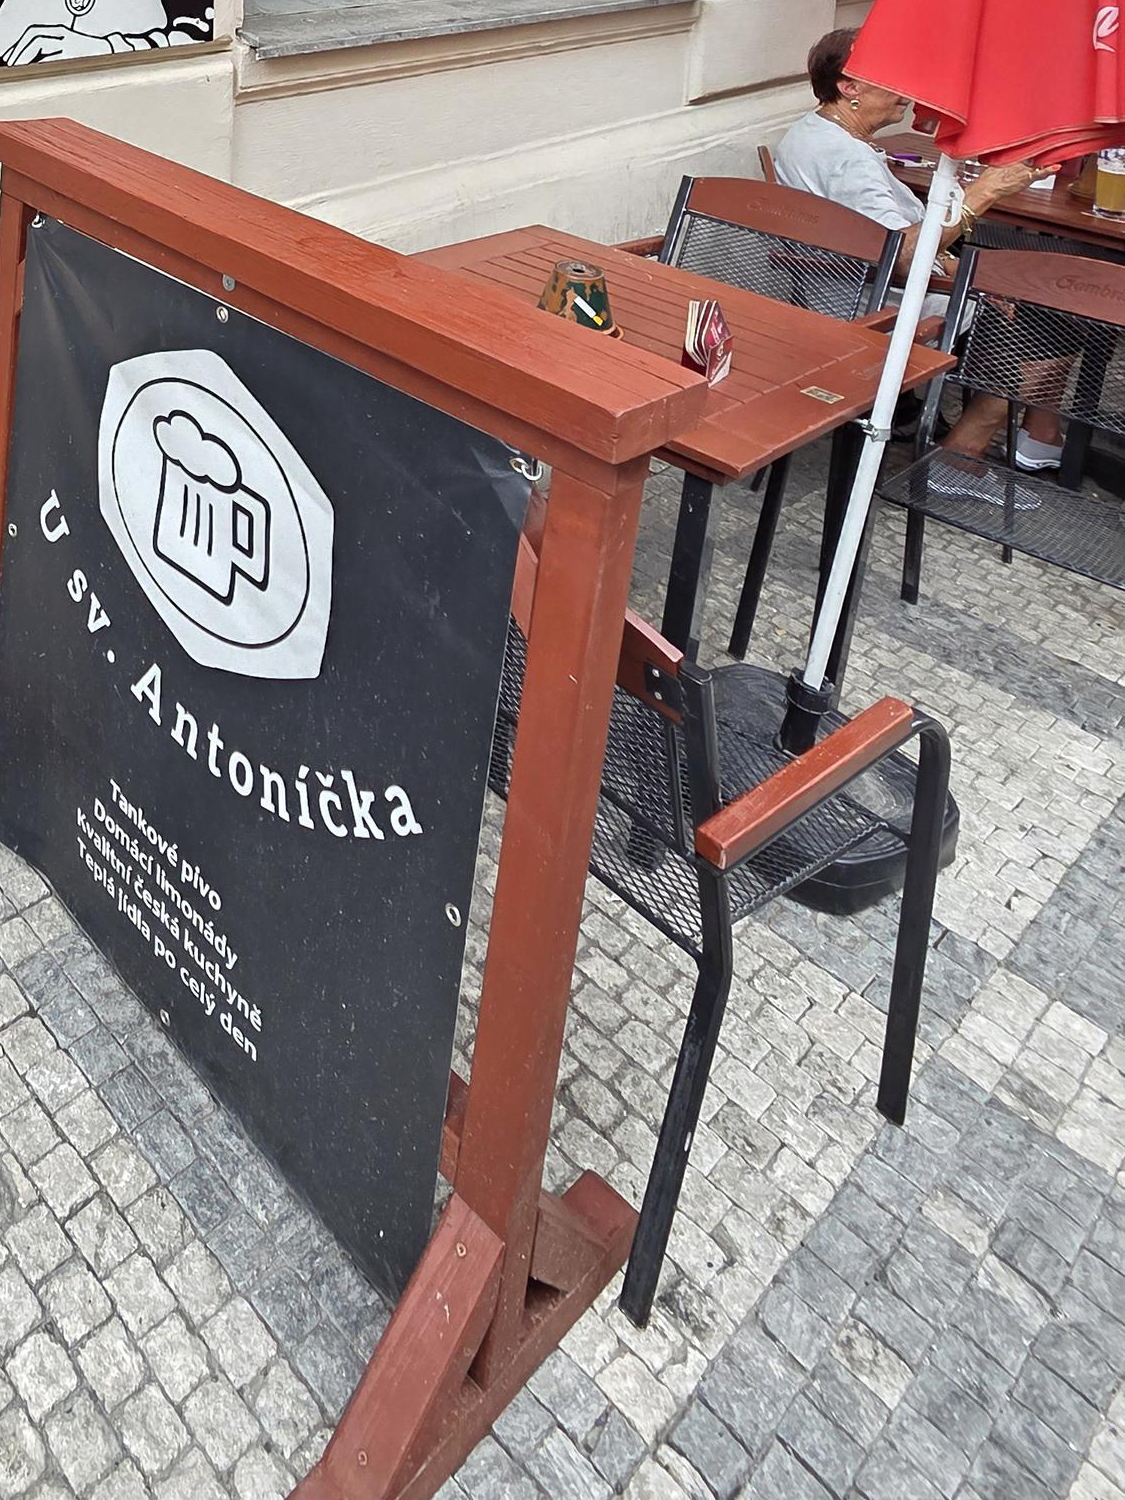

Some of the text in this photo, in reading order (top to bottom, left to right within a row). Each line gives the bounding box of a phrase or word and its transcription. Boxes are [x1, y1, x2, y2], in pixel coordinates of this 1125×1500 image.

[39, 488, 424, 841] U sv. Antoníčka
[76, 836, 257, 1062] Teplá jídla po celý den
[77, 807, 262, 1033] Kvalitní česká kuchyně
[93, 797, 238, 970] Domácí limonády
[109, 778, 222, 911] Tankové pivo
